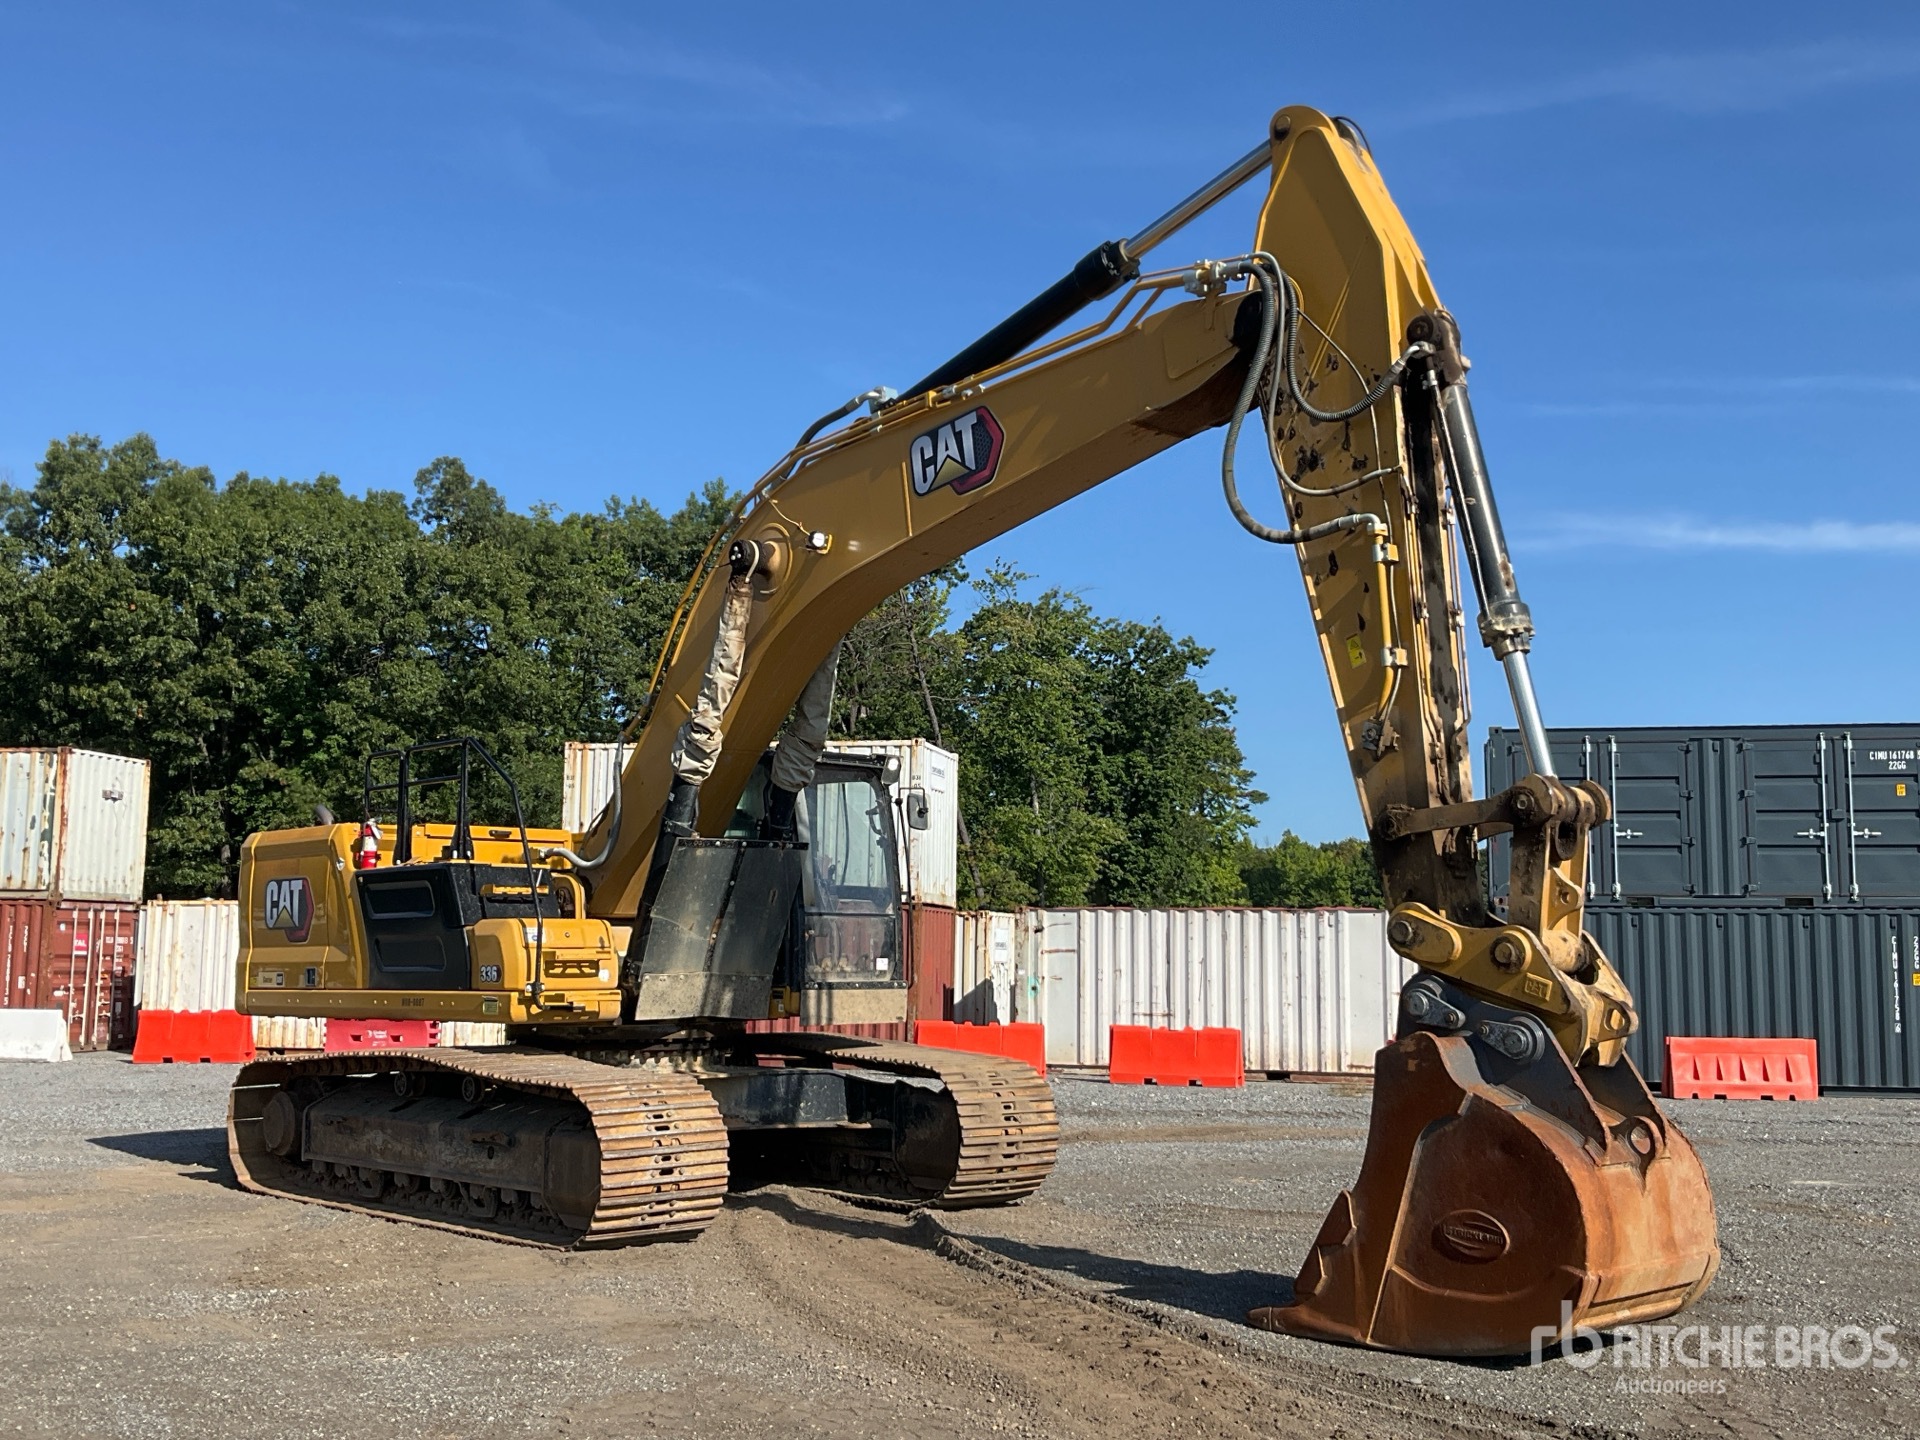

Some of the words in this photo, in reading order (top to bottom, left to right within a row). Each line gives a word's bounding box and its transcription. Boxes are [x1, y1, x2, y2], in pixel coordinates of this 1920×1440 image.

[911, 411, 977, 494] CAT
[1889, 761, 1907, 770] 22GG
[266, 880, 302, 928] CAT
[480, 966, 498, 982] 336
